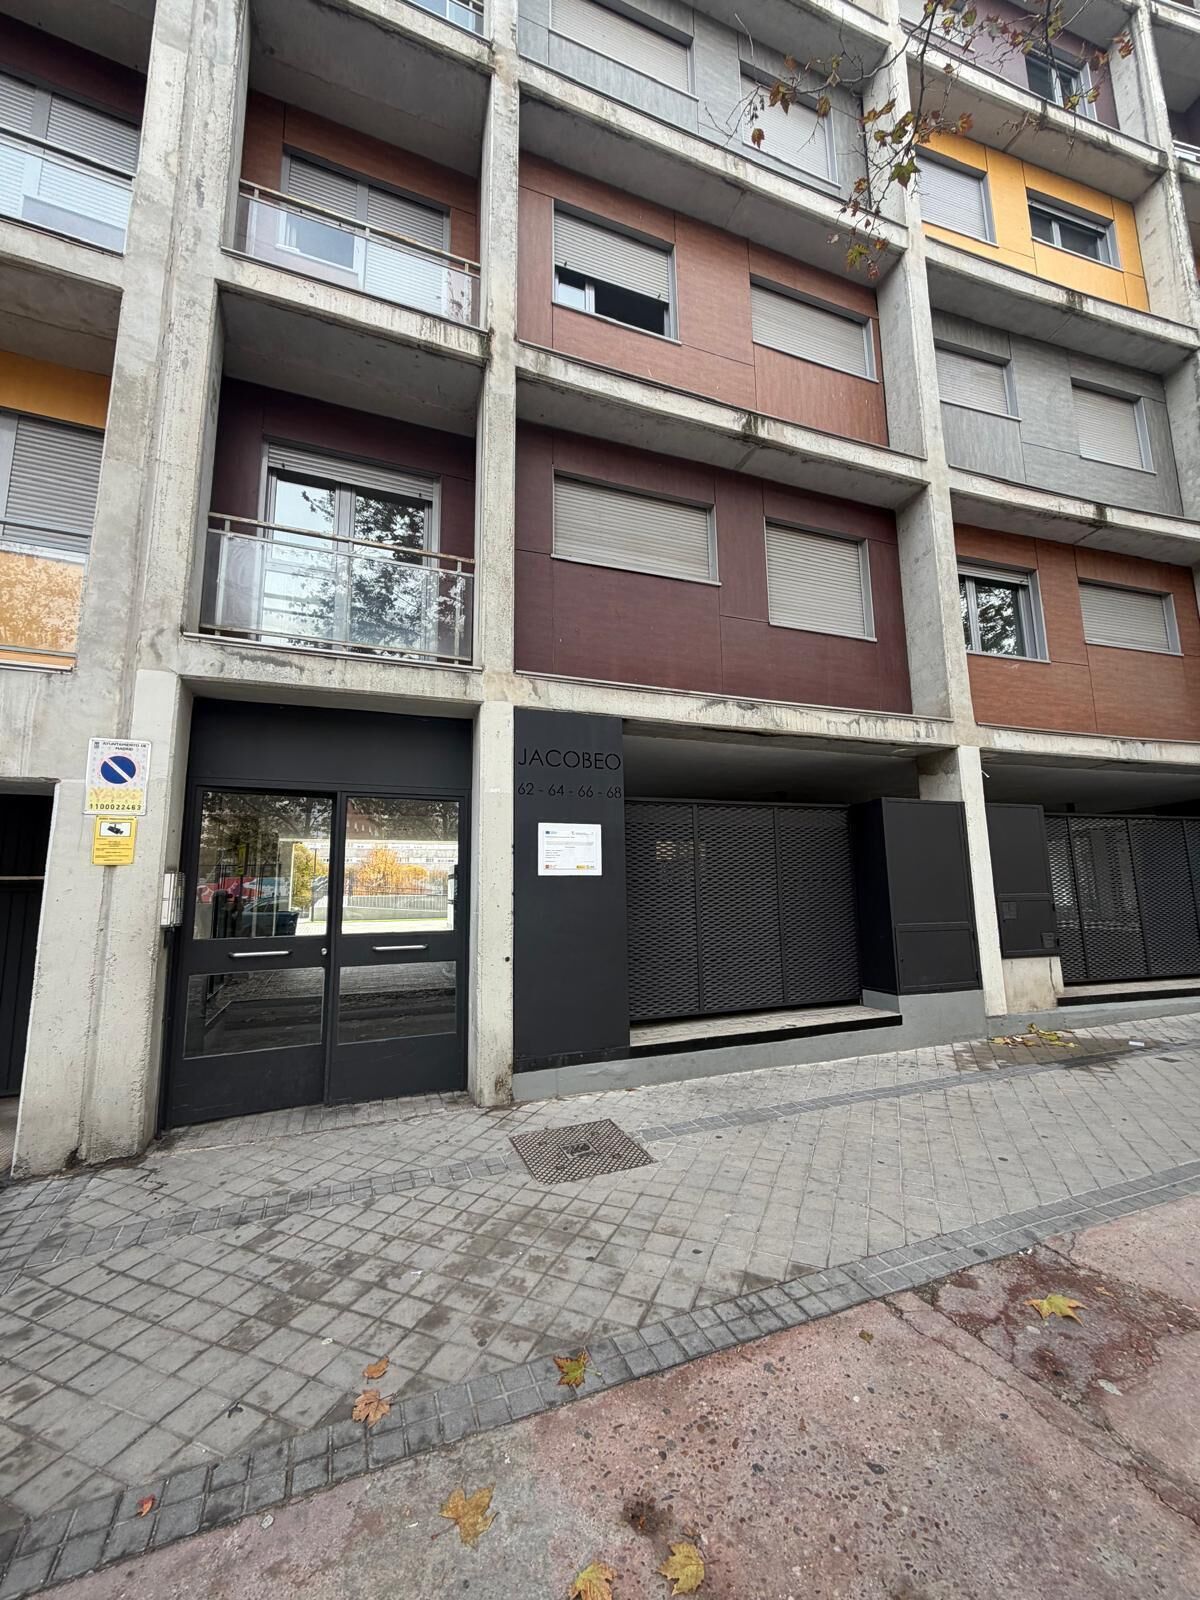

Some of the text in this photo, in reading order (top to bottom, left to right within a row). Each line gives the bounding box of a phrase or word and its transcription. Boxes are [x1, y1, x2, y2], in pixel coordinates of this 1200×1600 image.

[518, 748, 621, 770] JACOBEO
[518, 782, 534, 796] 62
[548, 784, 565, 797] 64
[578, 785, 594, 798] 66
[606, 786, 622, 799] 68
